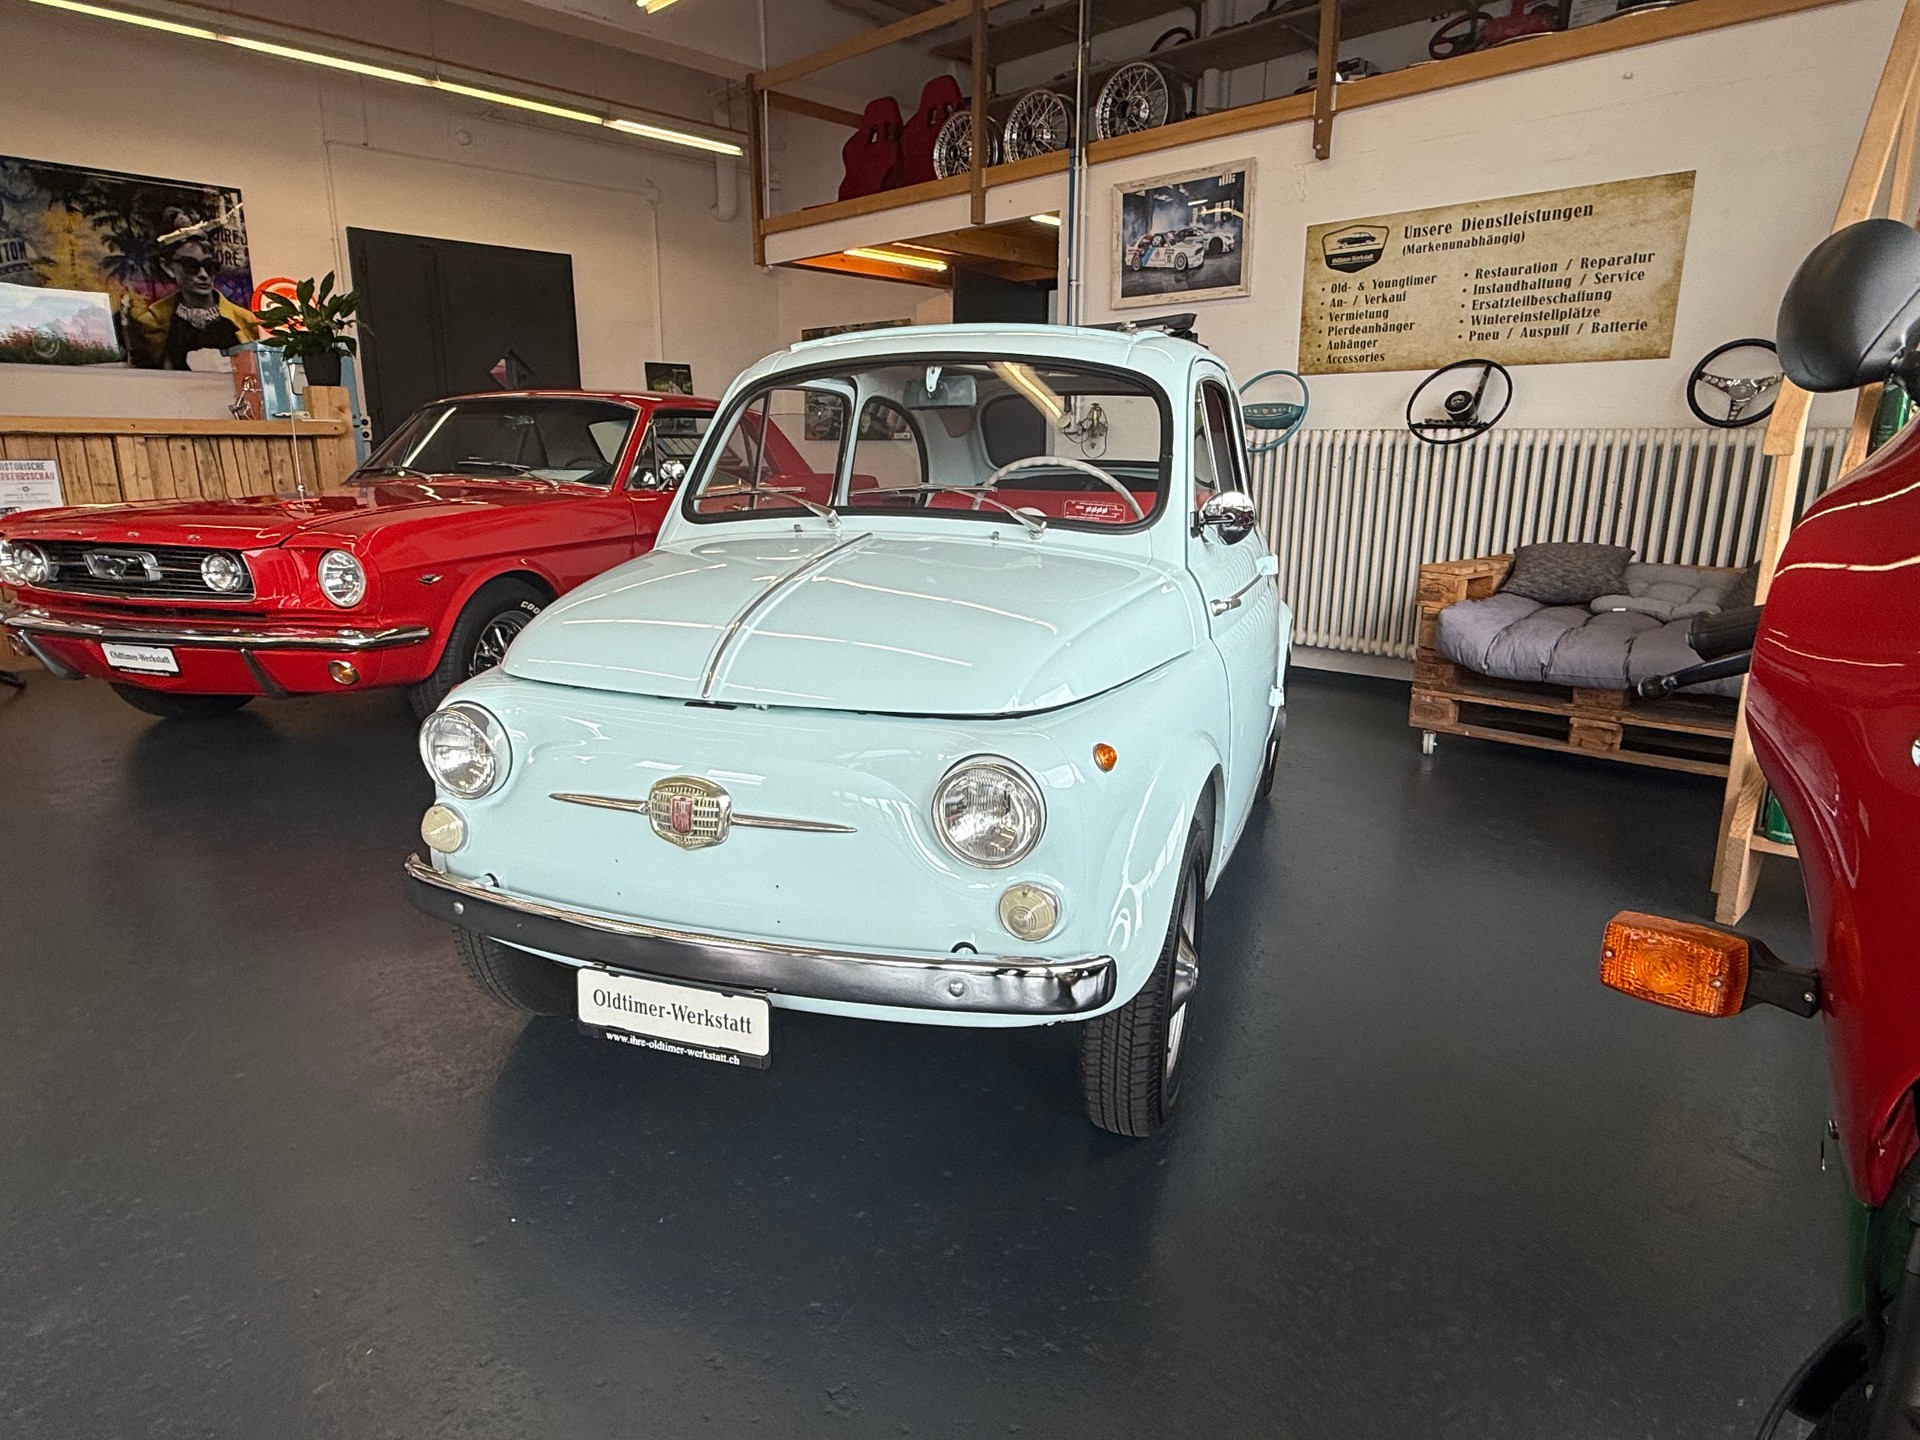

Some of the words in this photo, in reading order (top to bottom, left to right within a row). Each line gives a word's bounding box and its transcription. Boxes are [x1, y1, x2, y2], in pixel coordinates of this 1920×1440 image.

[1404, 222, 1452, 239] Unsere
[1461, 204, 1593, 232] Dienstleistungen
[1402, 231, 1525, 256] (Markenunabhängig)
[1475, 261, 1558, 280] Restauration
[1565, 259, 1573, 271] /
[1580, 252, 1656, 270] Reparatur
[1330, 282, 1352, 294] Old-
[1357, 281, 1365, 291] &
[1372, 274, 1437, 290] Youngtimer
[1473, 276, 1572, 295] Instandhaltung
[1579, 274, 1587, 286] /
[1594, 269, 1645, 285] Service
[1329, 297, 1348, 308] An-
[1352, 295, 1358, 306] /
[1364, 290, 1407, 305] Verkauf
[1471, 289, 1612, 311] Ersatzteilbeschaffung
[1329, 309, 1389, 322] Vermietung
[1470, 306, 1601, 326] Wintereinstellplätze
[1327, 322, 1416, 336] Pferdeanhänger
[1469, 329, 1500, 342] Pneu
[1506, 327, 1514, 340] /
[1519, 323, 1570, 339] Auspuff
[1576, 323, 1584, 336] /
[1591, 319, 1648, 334] Batterie
[1326, 339, 1379, 351] Anhänger
[1325, 352, 1386, 364] Accessories
[593, 988, 752, 1034] Oldtimer-Werkstatt
[605, 1031, 740, 1066] www.ihre-oldtimer-werkstatt.ch
